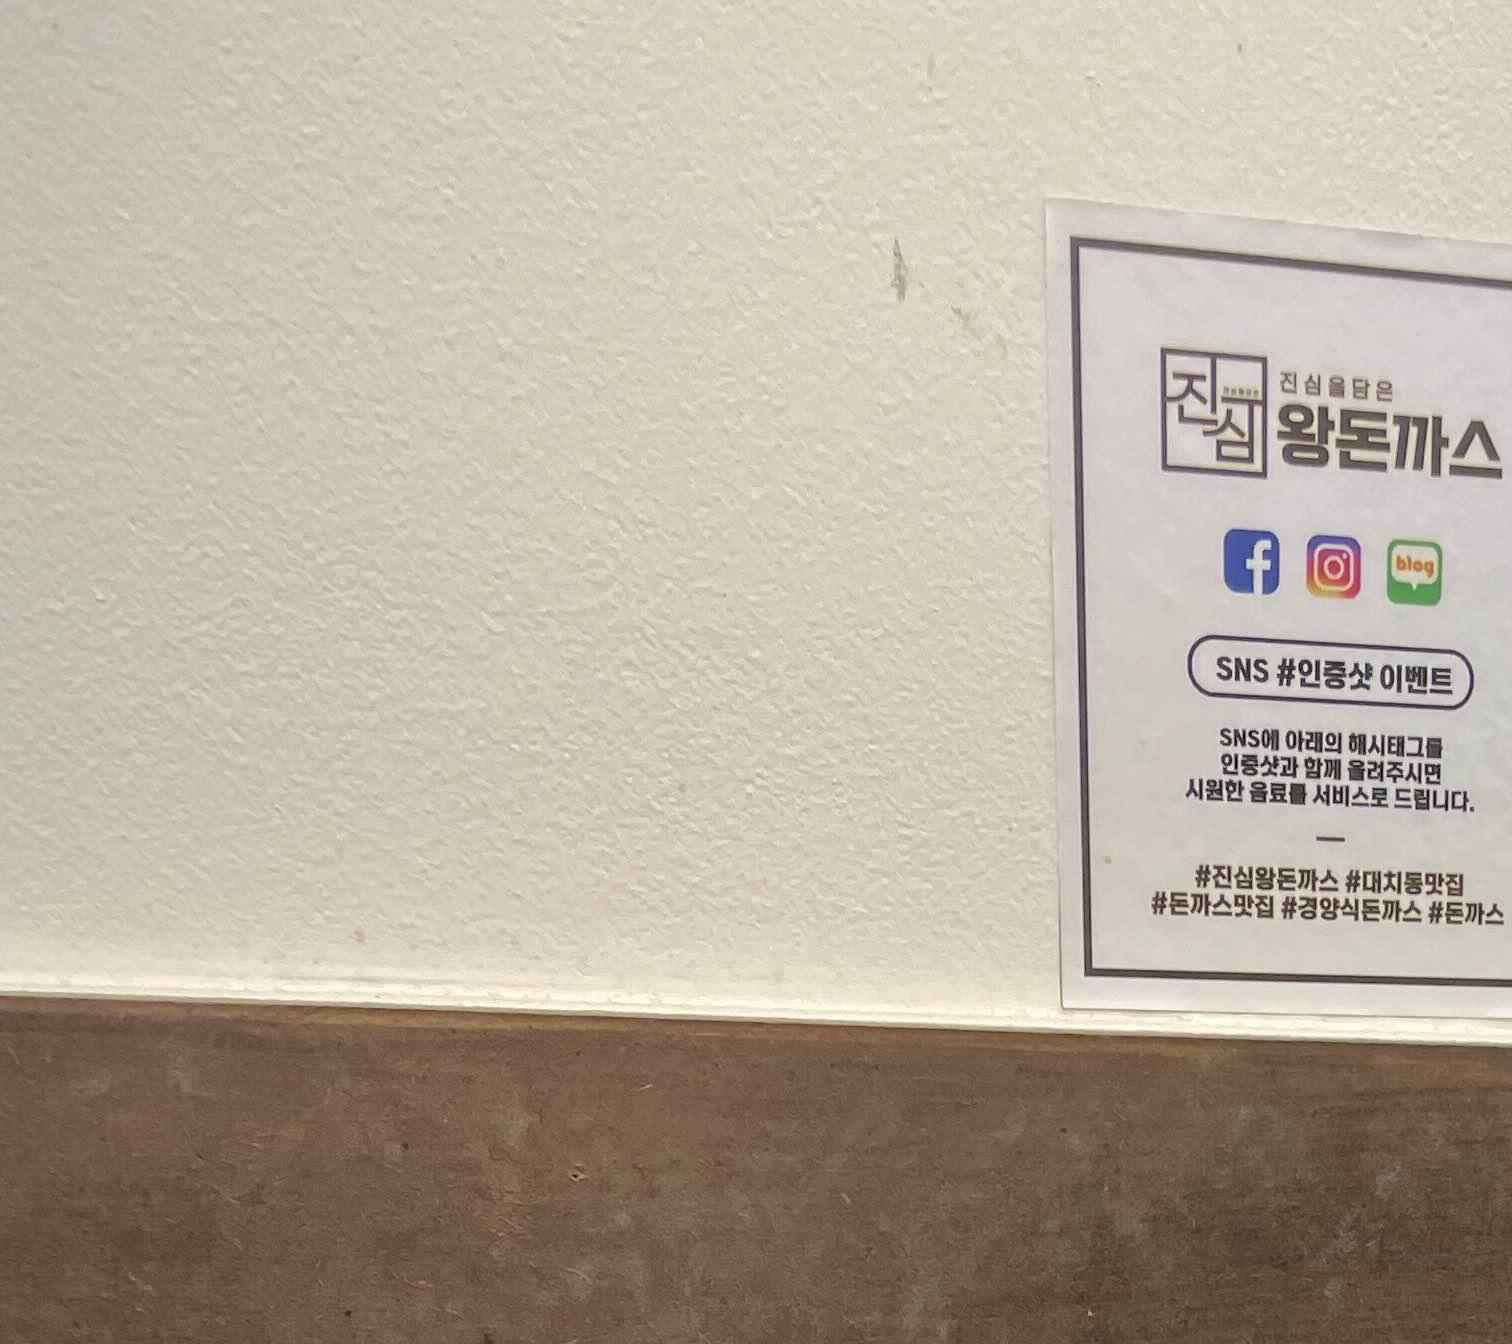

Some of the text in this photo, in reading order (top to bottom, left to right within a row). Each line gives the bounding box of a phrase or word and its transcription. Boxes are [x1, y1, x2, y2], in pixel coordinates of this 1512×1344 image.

[1279, 370, 1393, 402] 진심을담은
[1277, 403, 1503, 480] 왕돈까스
[1396, 555, 1435, 578] blog
[1216, 656, 1453, 694] SNS #인증샷 이벤트
[1219, 727, 1443, 759] SNS에 아래의 해시태그를
[1221, 753, 1442, 785] 인증샷과 함께 올려주시면
[1185, 778, 1475, 813] 시원한 음료를 서비스로 드립니다.
[1195, 863, 1464, 897] #진심왕돈까스 #대치동맛집
[1151, 890, 1504, 926] #돈까스맛집 #경양식돈까스 #돈까스
